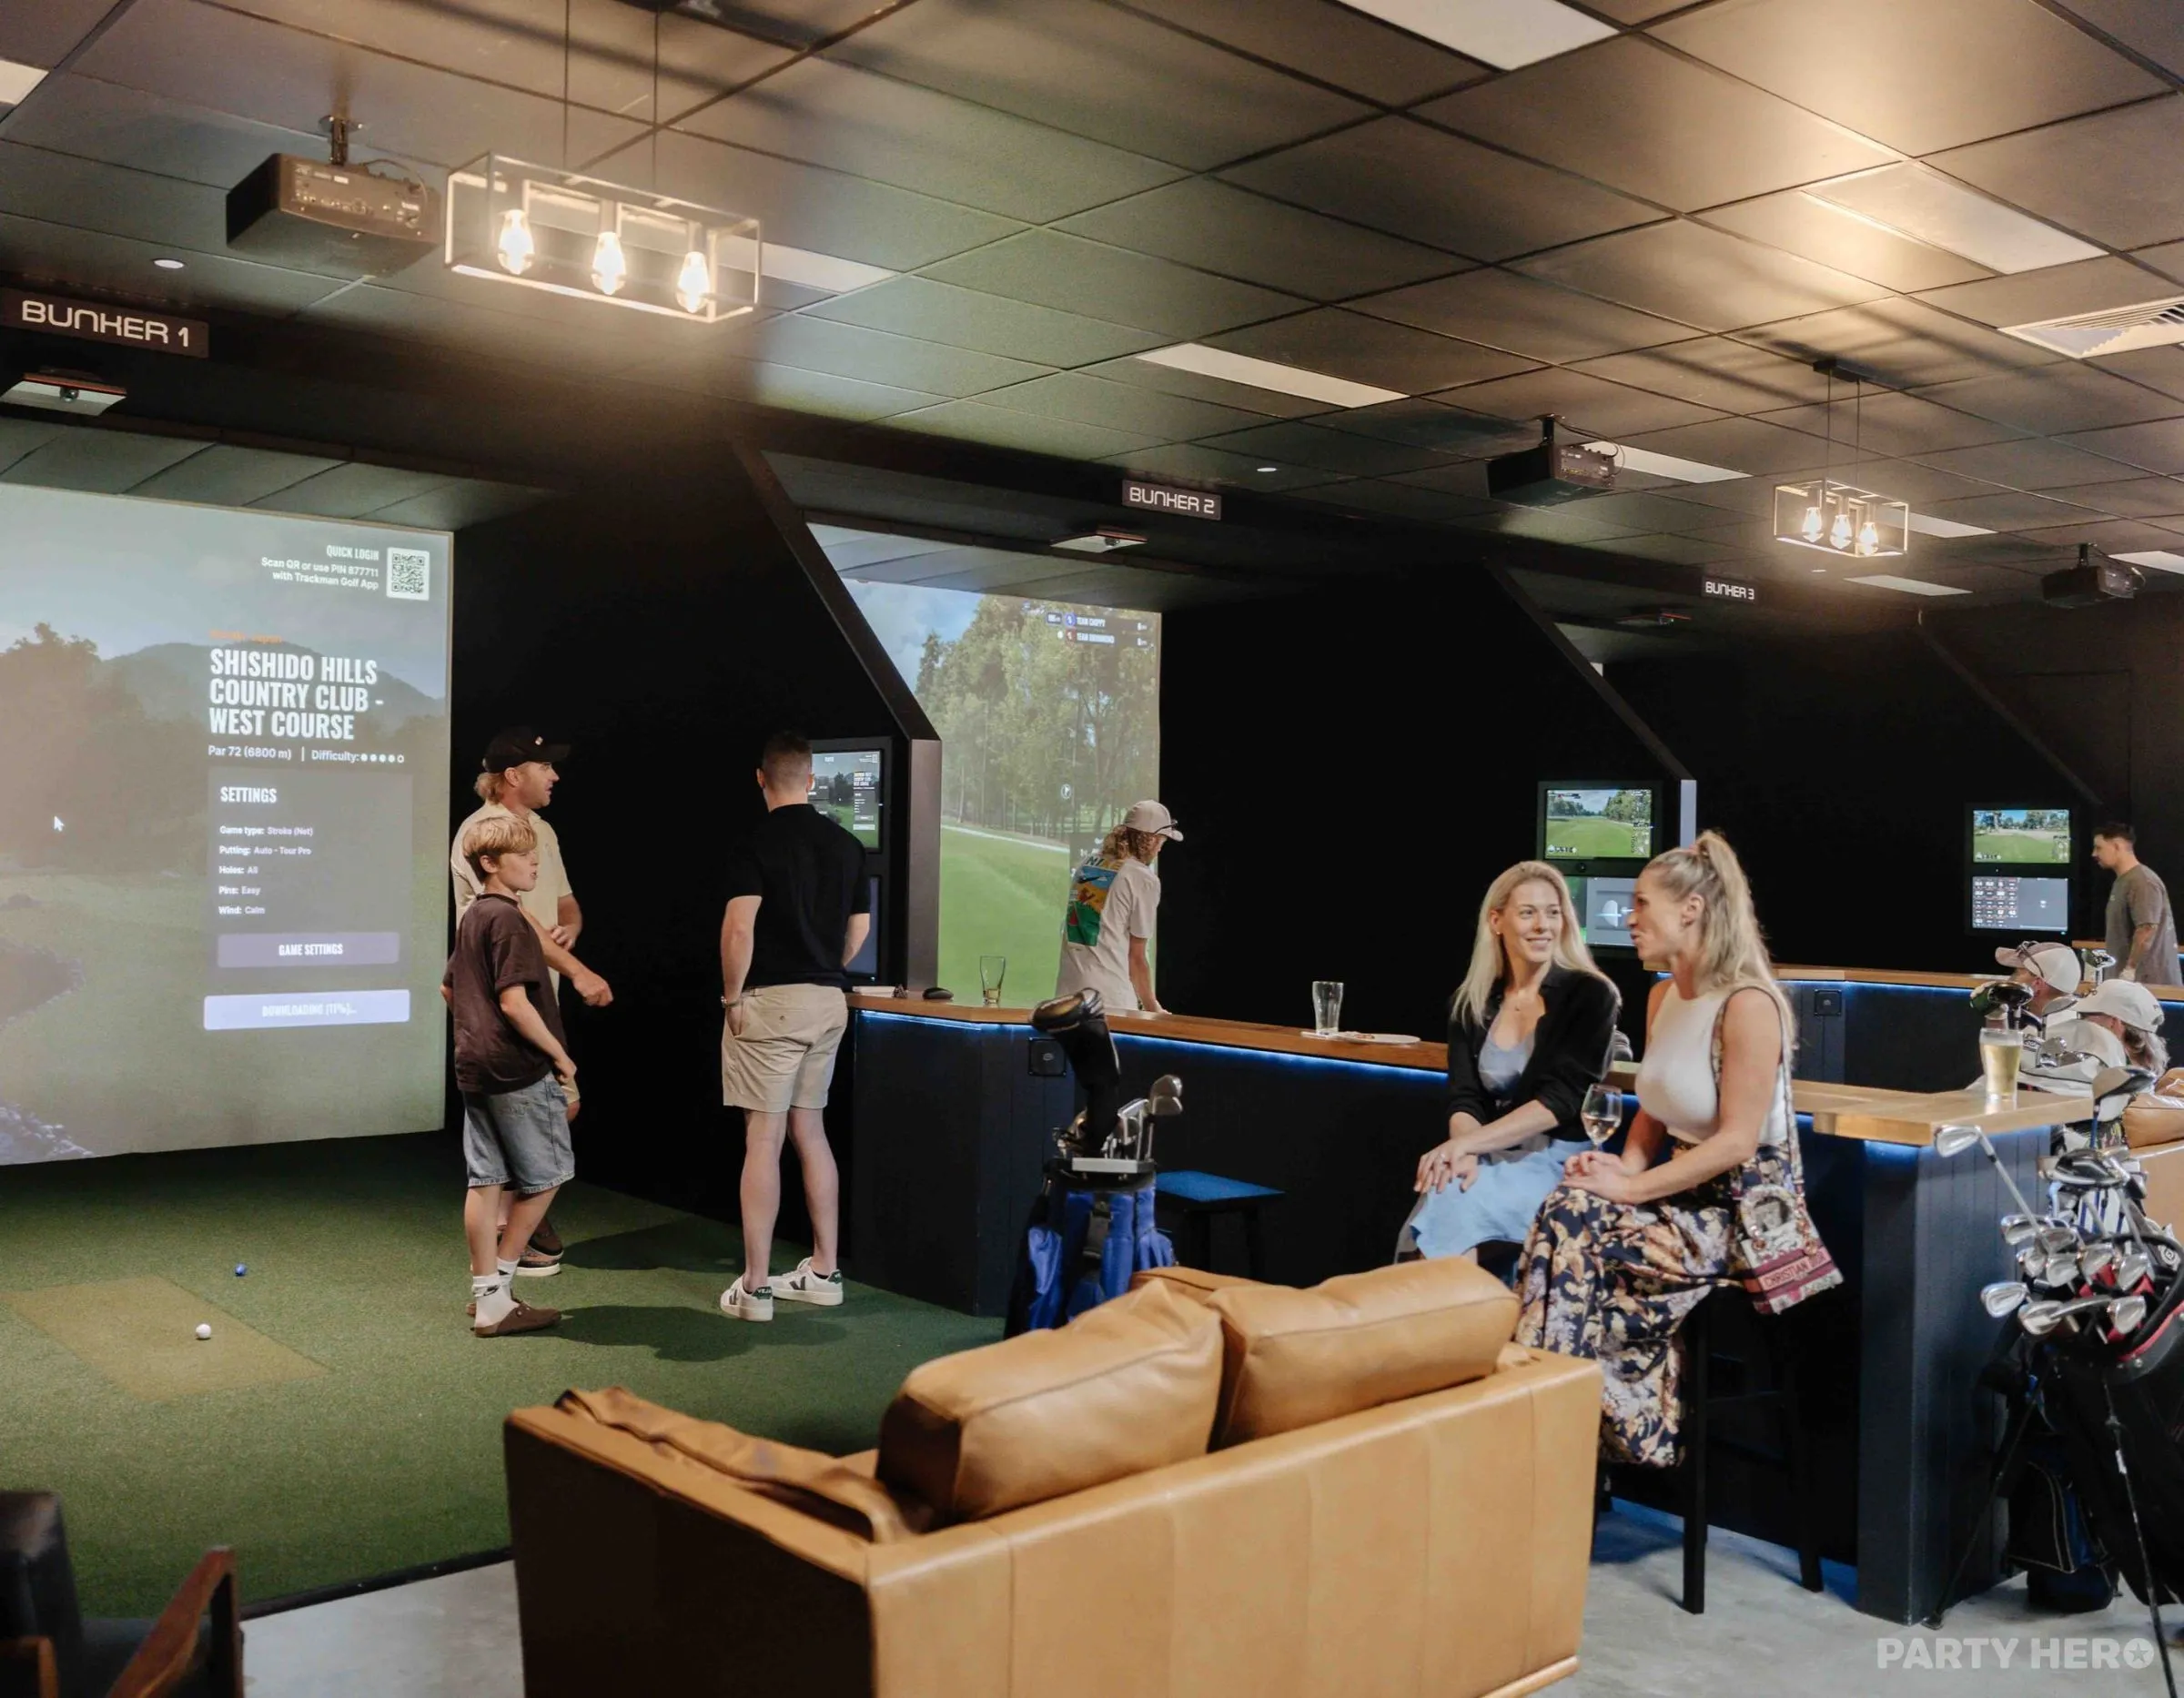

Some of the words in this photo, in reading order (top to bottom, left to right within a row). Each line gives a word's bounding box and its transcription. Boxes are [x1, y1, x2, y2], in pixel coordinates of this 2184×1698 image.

[22, 300, 168, 344] BUNKER
[178, 327, 189, 347] 1
[1129, 487, 1199, 511] BUNKER
[1204, 499, 1215, 514] 2
[327, 545, 353, 558] QUICK
[354, 548, 379, 561] LOGIN
[261, 557, 285, 568] Scan
[286, 560, 300, 570] QR
[301, 562, 311, 571] or
[313, 564, 329, 573] use
[330, 564, 347, 574] PIN
[272, 571, 293, 581] with
[295, 572, 339, 585] Trackman
[340, 577, 359, 587] Golf
[359, 580, 379, 591] App
[1705, 581, 1746, 598] BUNKER
[1748, 588, 1755, 600] 3
[209, 648, 314, 681] SHISHIDO
[320, 656, 378, 684] HILLS
[209, 678, 309, 709] COUNTRY
[315, 684, 369, 712] CLUB
[208, 707, 266, 735] WEST
[271, 711, 354, 740] COURSE
[207, 745, 226, 756] Par
[228, 746, 241, 757] 72
[244, 746, 276, 759] (6800
[278, 748, 292, 761] m)
[311, 750, 359, 763] Difficulty:
[220, 786, 278, 804] SETTINGS
[219, 825, 243, 834] Game
[254, 846, 273, 855] Auto
[278, 945, 303, 956] GAME
[304, 943, 343, 955] SETTINGS
